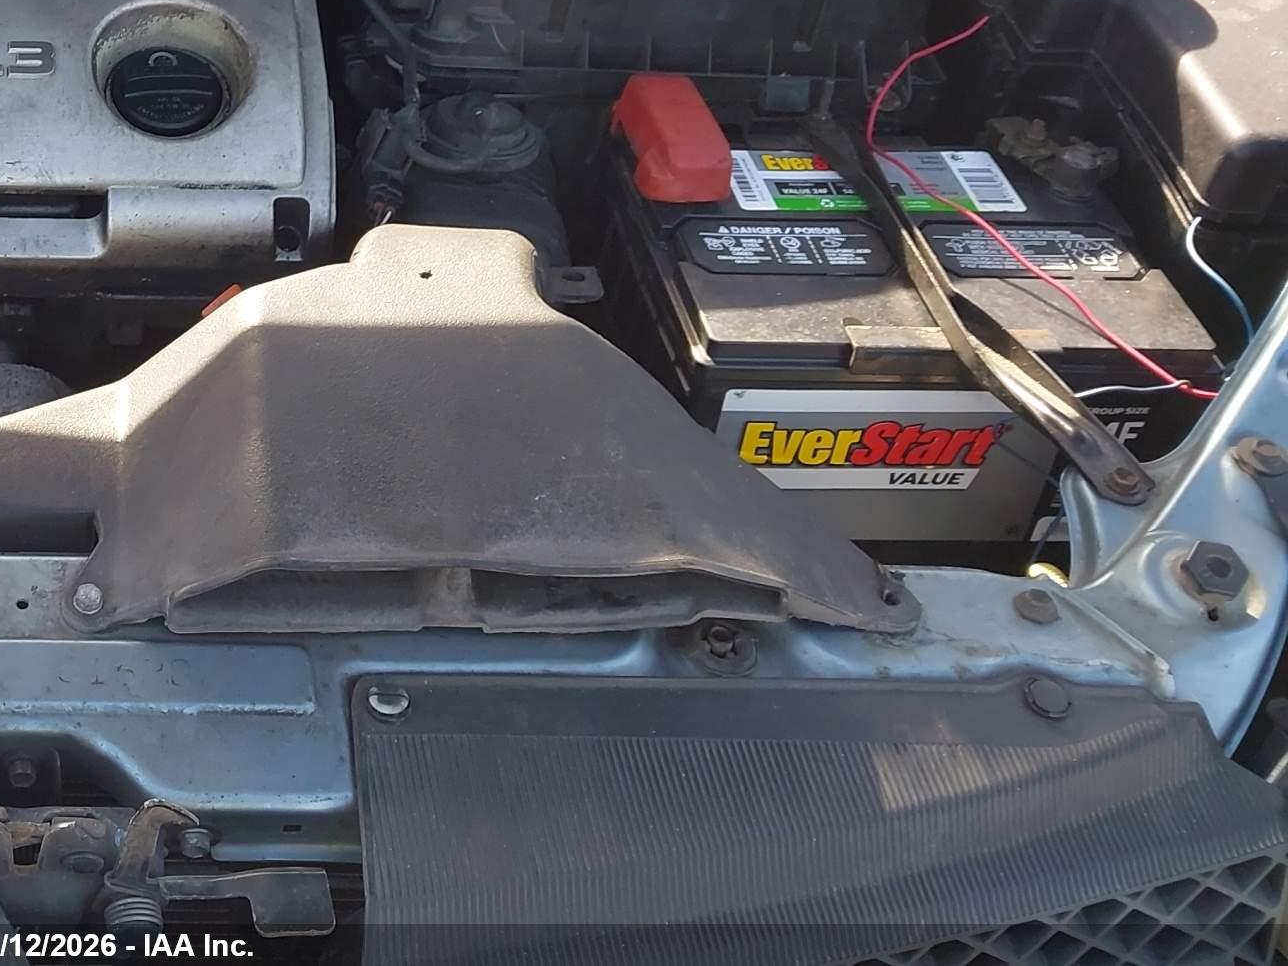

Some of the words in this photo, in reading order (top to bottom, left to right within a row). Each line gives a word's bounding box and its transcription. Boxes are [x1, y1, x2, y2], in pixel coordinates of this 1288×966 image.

[762, 153, 830, 171] EverS
[730, 226, 783, 235] DANGER
[793, 226, 842, 235] POISON
[738, 420, 996, 467] EverStart
[888, 472, 965, 485] VALUE
